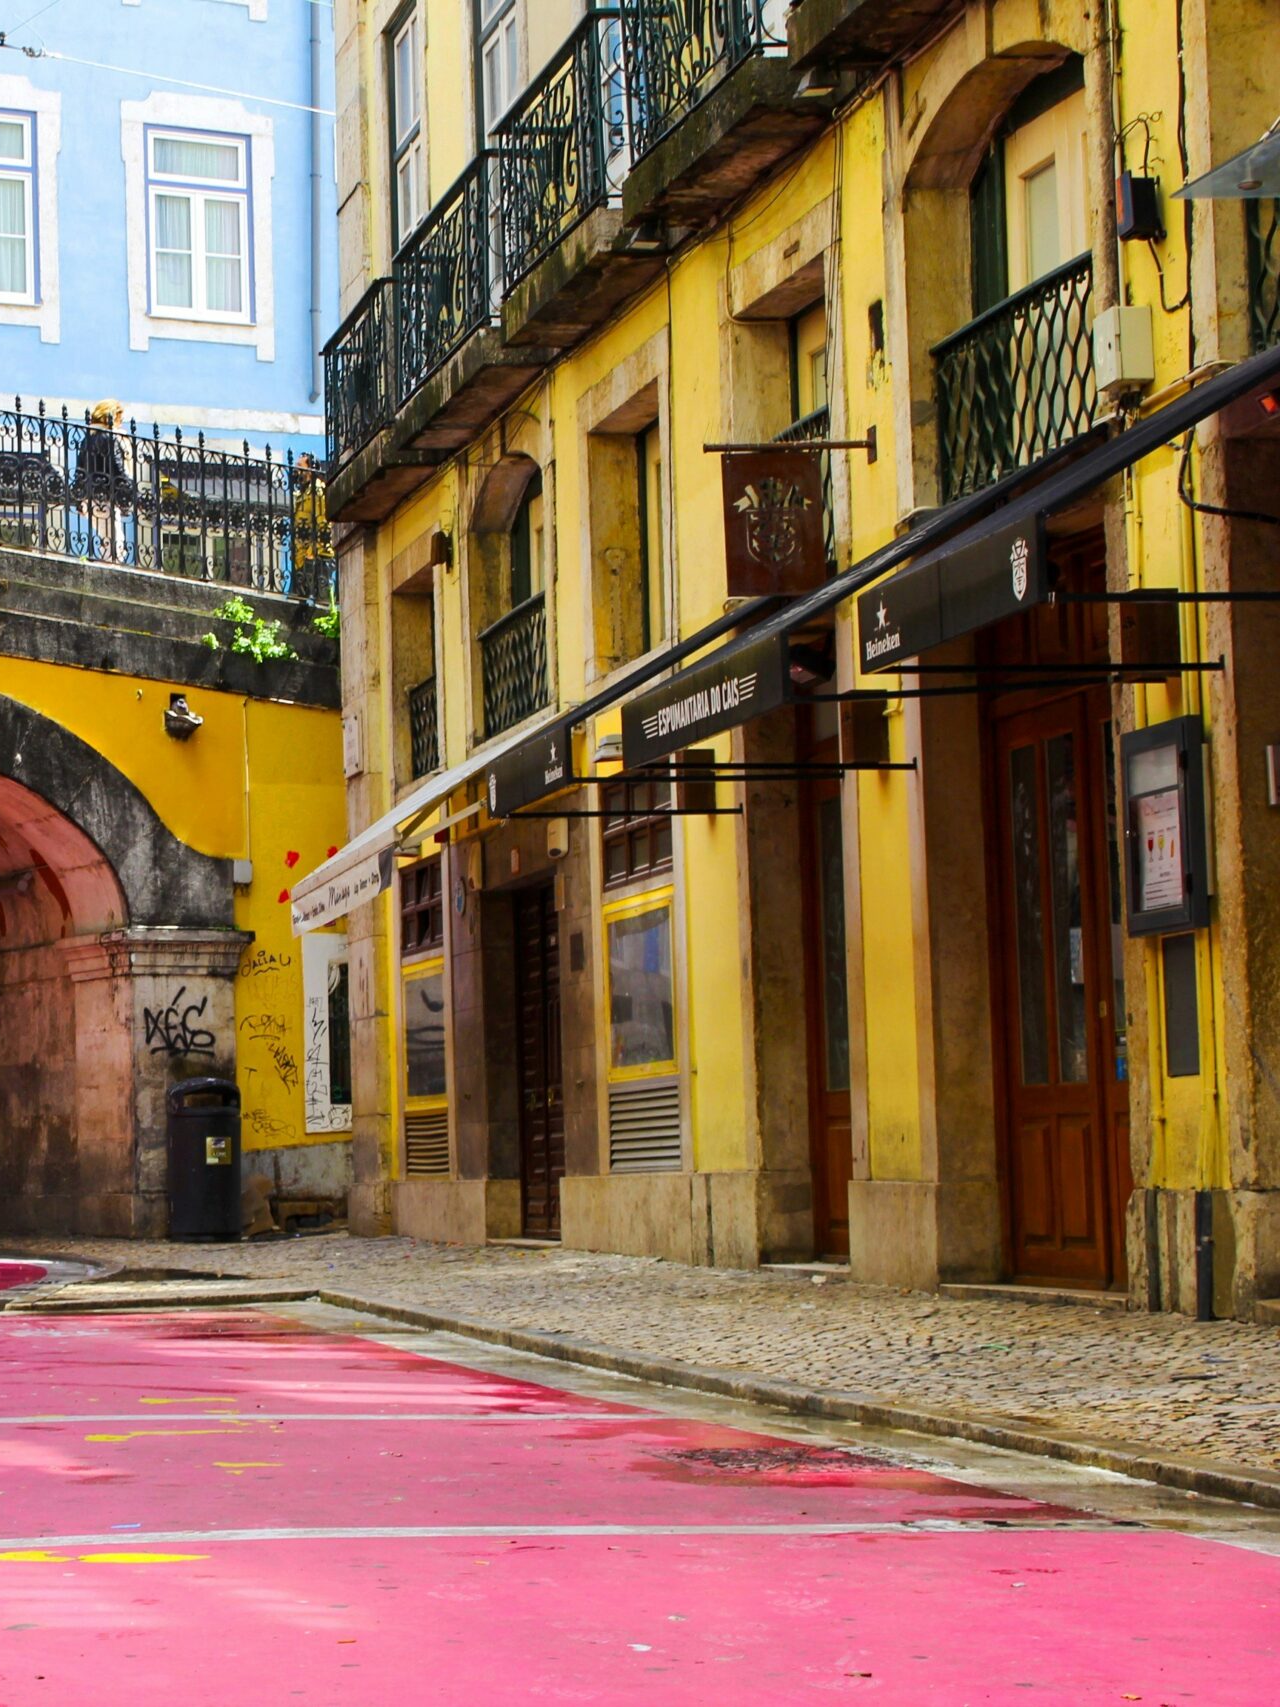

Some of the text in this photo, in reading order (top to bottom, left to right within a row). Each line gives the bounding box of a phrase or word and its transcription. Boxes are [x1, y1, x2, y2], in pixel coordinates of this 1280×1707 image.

[865, 632, 901, 661] Heineken
[658, 677, 739, 737] ESPUMANTARIA DO CAIS
